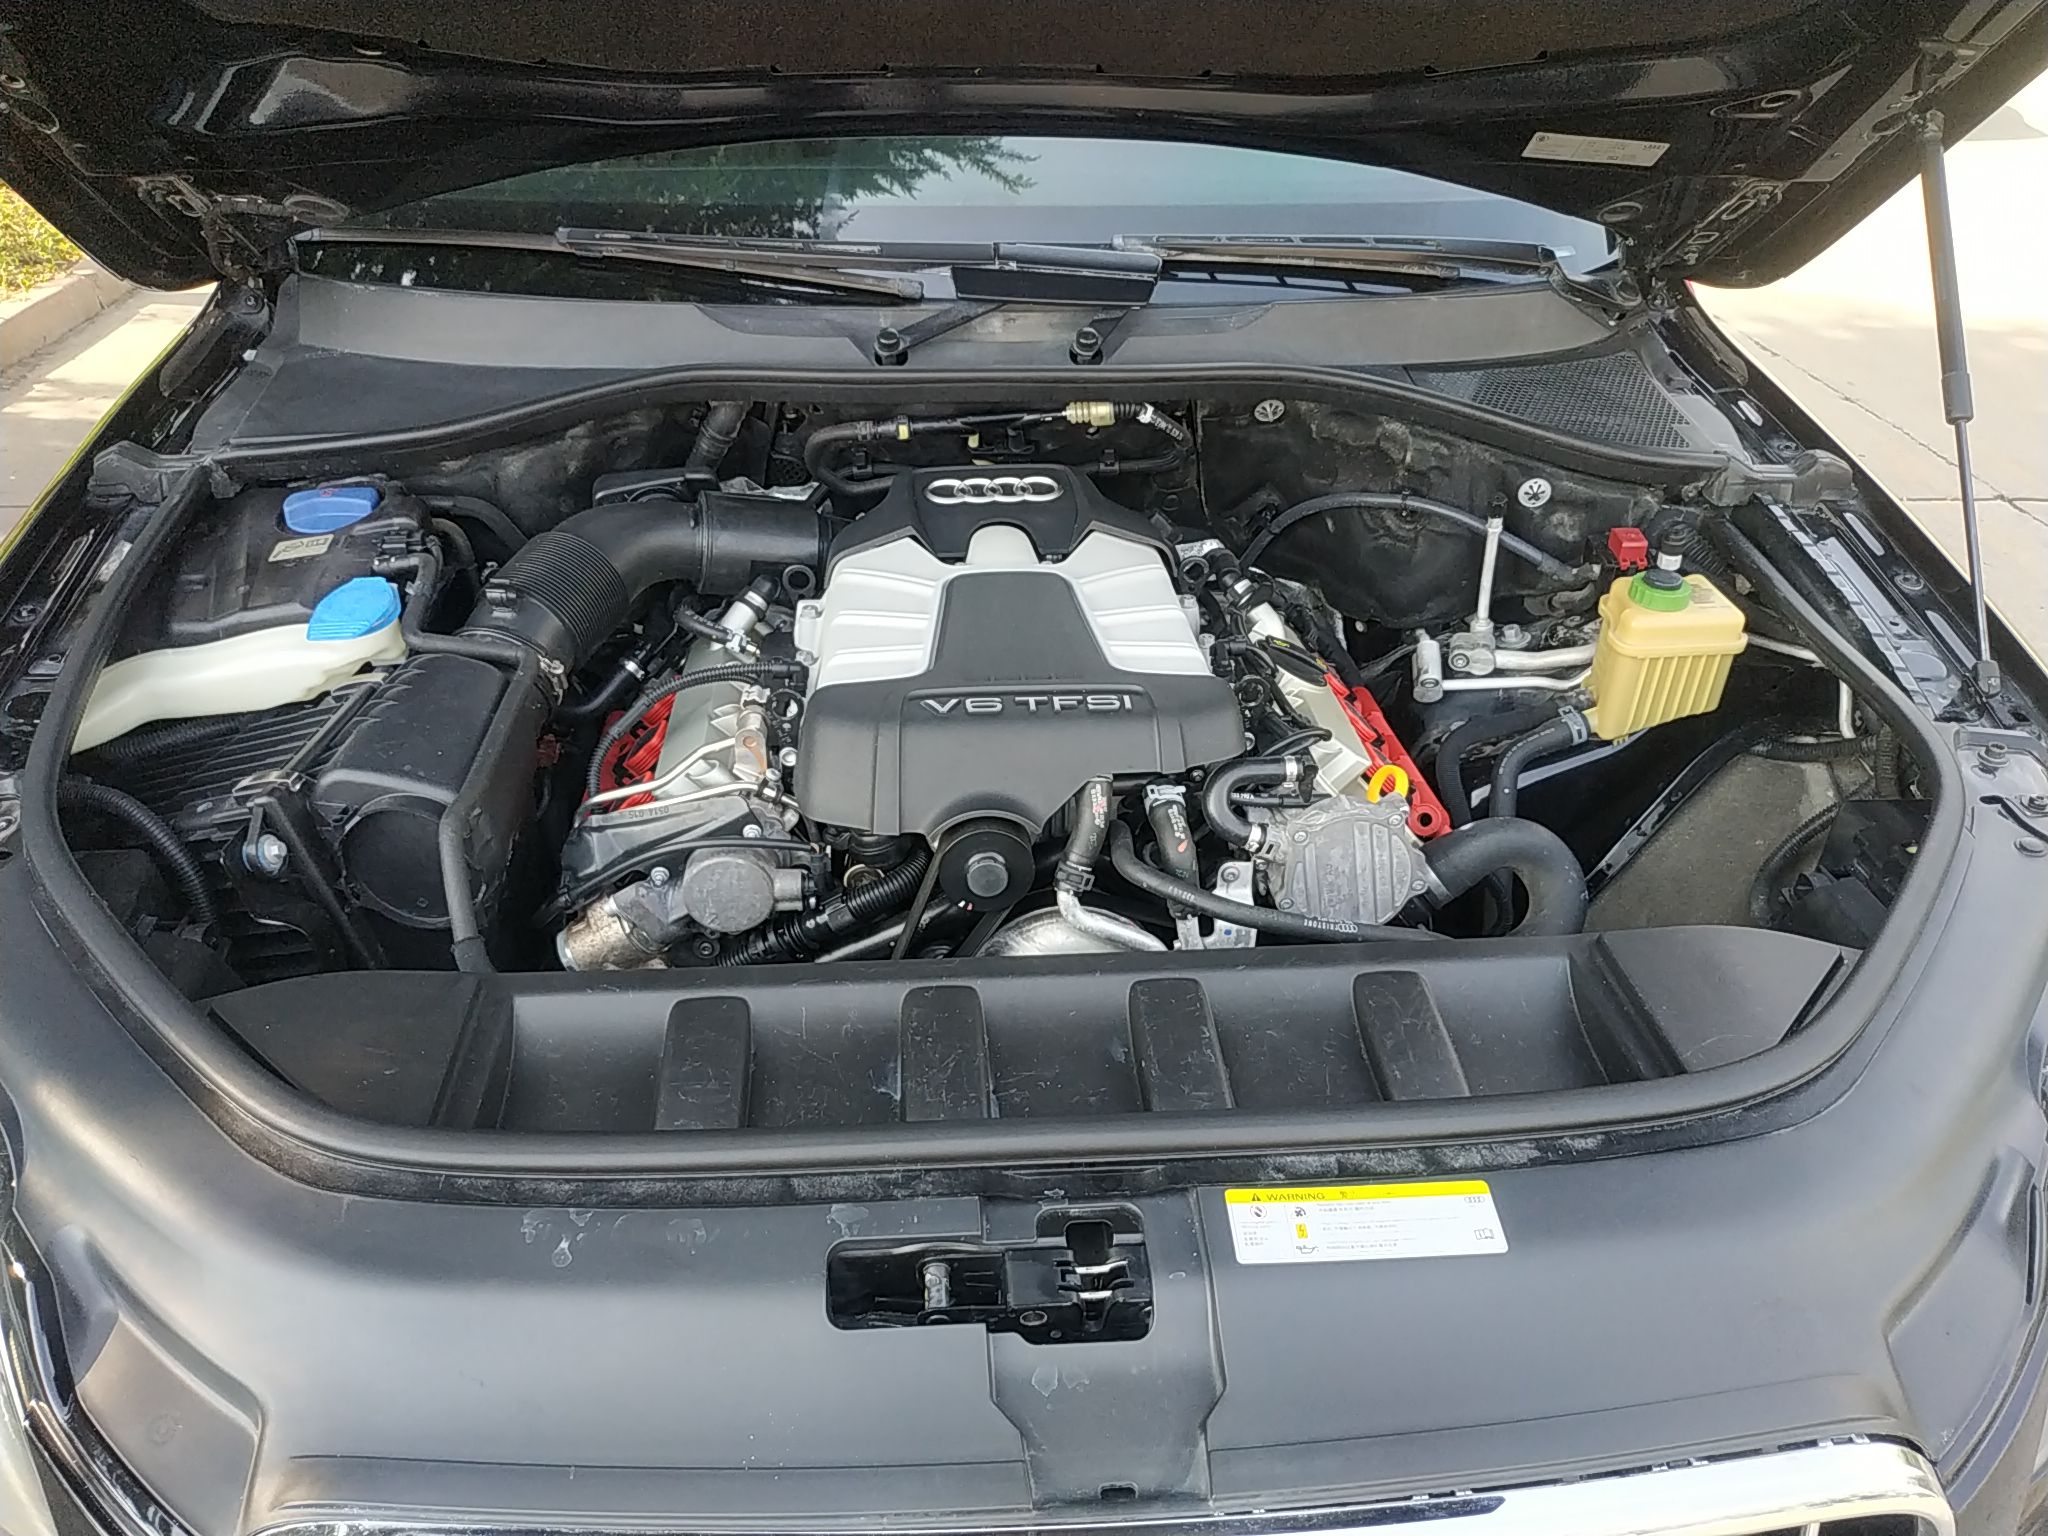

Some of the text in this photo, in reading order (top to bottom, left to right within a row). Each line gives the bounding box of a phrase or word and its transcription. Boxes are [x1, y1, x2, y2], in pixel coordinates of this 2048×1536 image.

[919, 694, 1133, 716] V6 TFSI
[1266, 1192, 1326, 1201] WARNING
